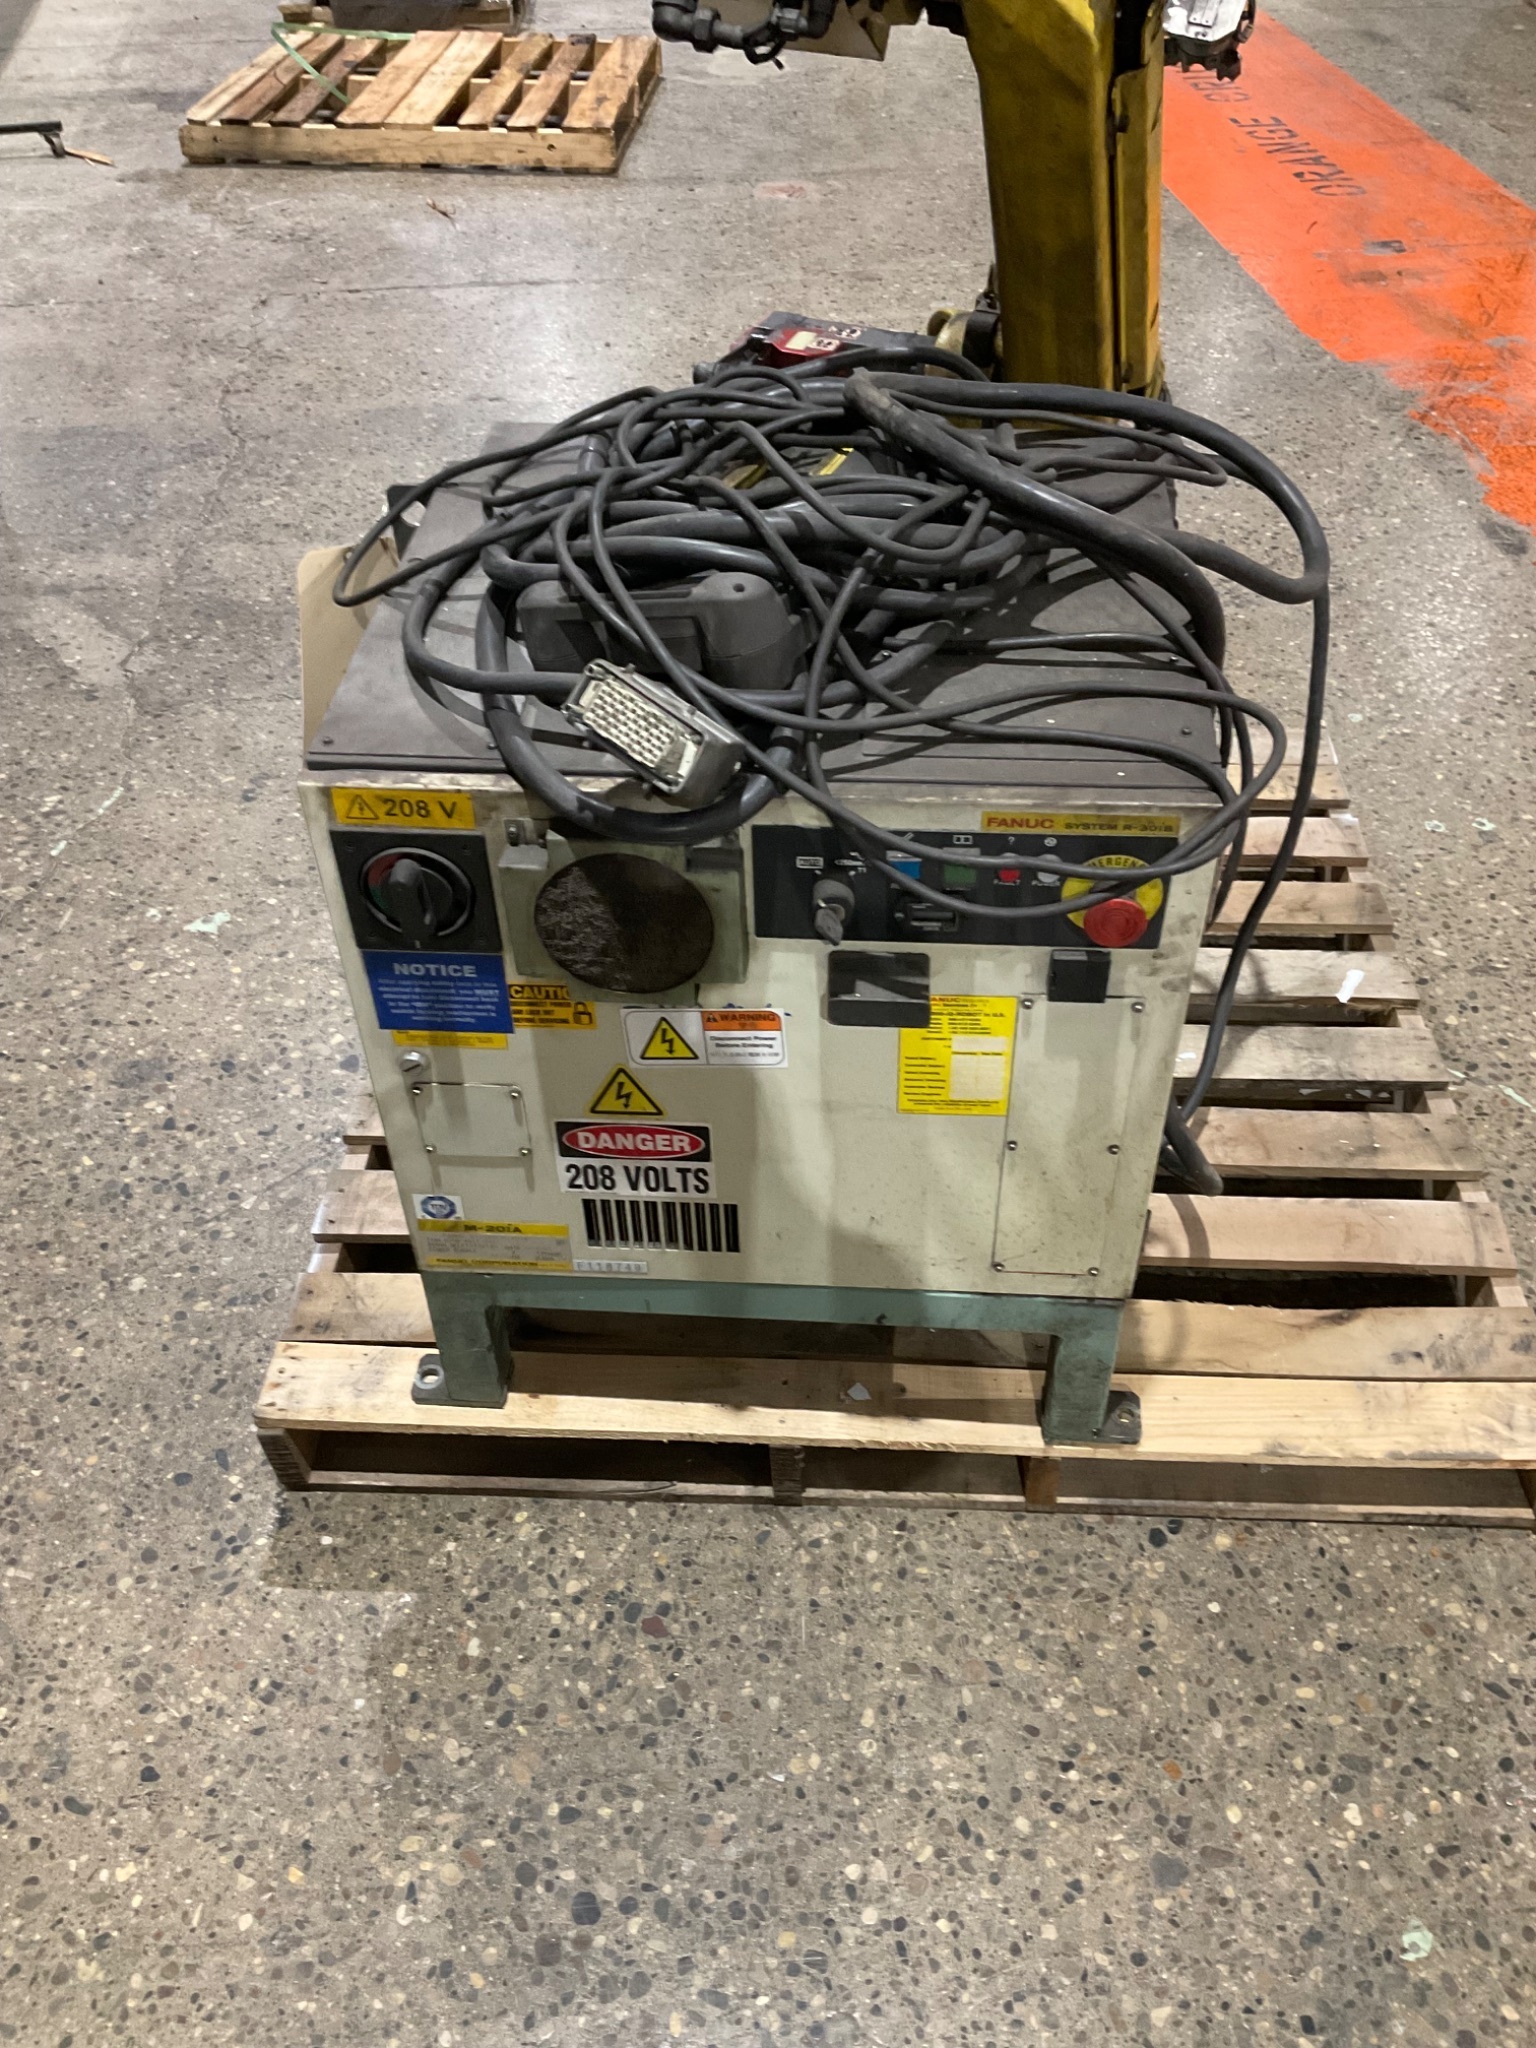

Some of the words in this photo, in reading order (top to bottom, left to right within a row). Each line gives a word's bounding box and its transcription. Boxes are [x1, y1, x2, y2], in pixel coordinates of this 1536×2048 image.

[1228, 115, 1367, 196] ORANGE
[383, 798, 430, 818] 208
[438, 800, 457, 819] V
[986, 816, 1055, 830] FANUC
[1064, 822, 1118, 831] SYSTEM
[393, 962, 478, 978] NOTICE
[510, 985, 570, 1000] CAUTI
[720, 1013, 776, 1022] WARNING
[577, 1131, 692, 1153] DANGER
[565, 1163, 616, 1191] 208
[623, 1165, 710, 1194] VOLTS
